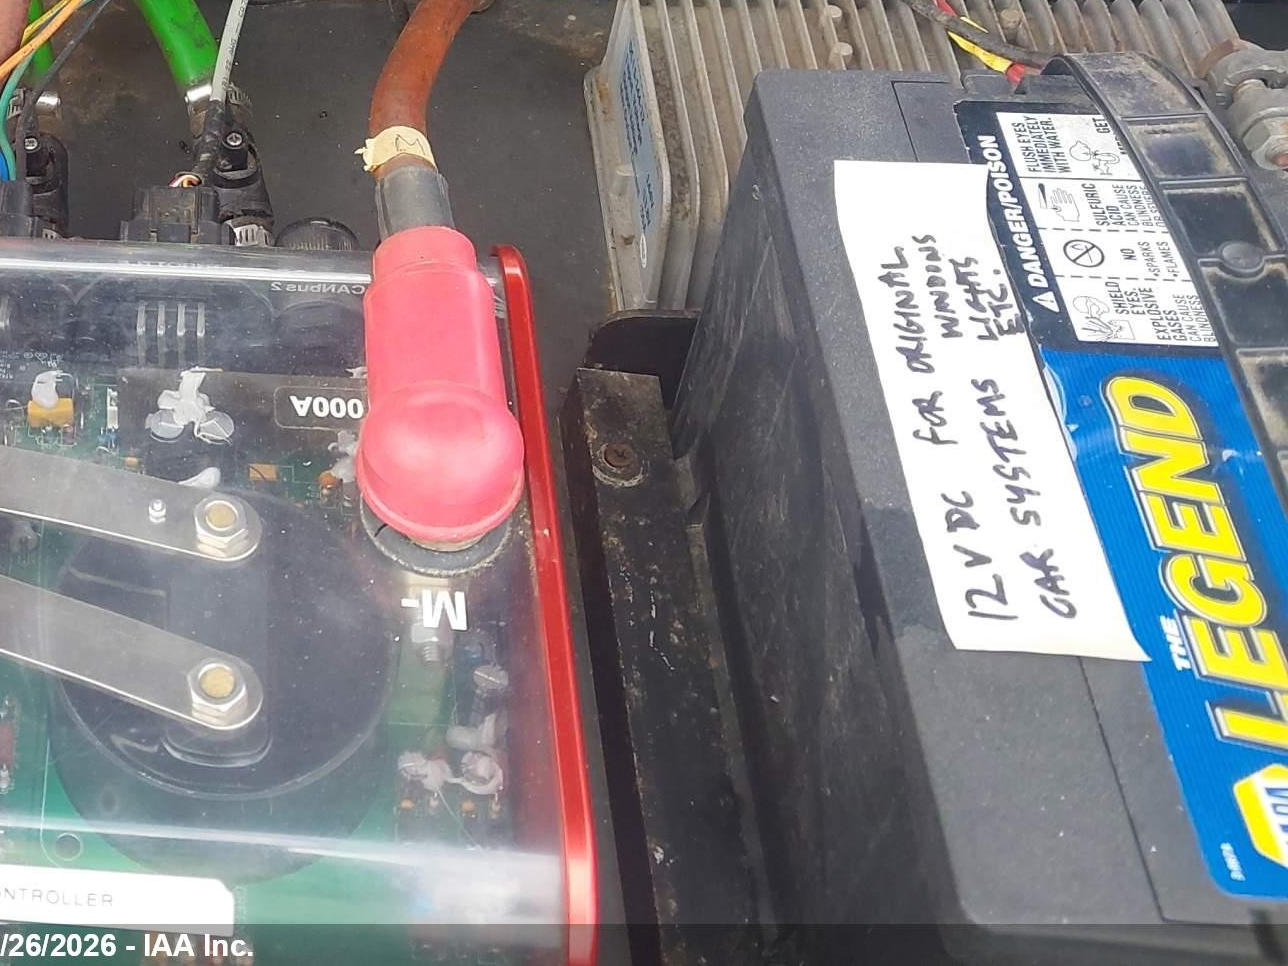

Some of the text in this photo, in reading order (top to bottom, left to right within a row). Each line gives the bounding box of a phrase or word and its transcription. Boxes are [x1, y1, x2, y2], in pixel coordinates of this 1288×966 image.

[1011, 122, 1042, 172] FLUSH EYES
[1023, 116, 1057, 173] IMMEDIATELY
[1040, 117, 1072, 173] WITH WATER.
[1092, 117, 1111, 134] GET
[978, 135, 1048, 289] DANGER/POISON
[1081, 183, 1110, 226] SULFURIC
[1105, 205, 1127, 226] ACID
[1112, 184, 1140, 226] CAN CAUSE
[1127, 184, 1154, 227] BLINDNESS
[1119, 248, 1137, 261] NO
[877, 246, 936, 374] ORIGINAL
[1105, 281, 1130, 315] SHIELD
[1124, 287, 1146, 315] EYES.
[1138, 287, 1172, 341] EXPLOSIVE
[1172, 294, 1202, 342] CAN CAUSE
[1186, 294, 1217, 343] BLINDNESS
[1162, 309, 1188, 342] GASES
[940, 490, 981, 533] DC
[970, 378, 1078, 620] CAR SYSTEMS
[952, 544, 993, 568] V
[1100, 376, 1288, 752] LEGEND
[400, 589, 468, 631] M-
[964, 573, 1019, 621] 12
[1160, 614, 1192, 672] THE
